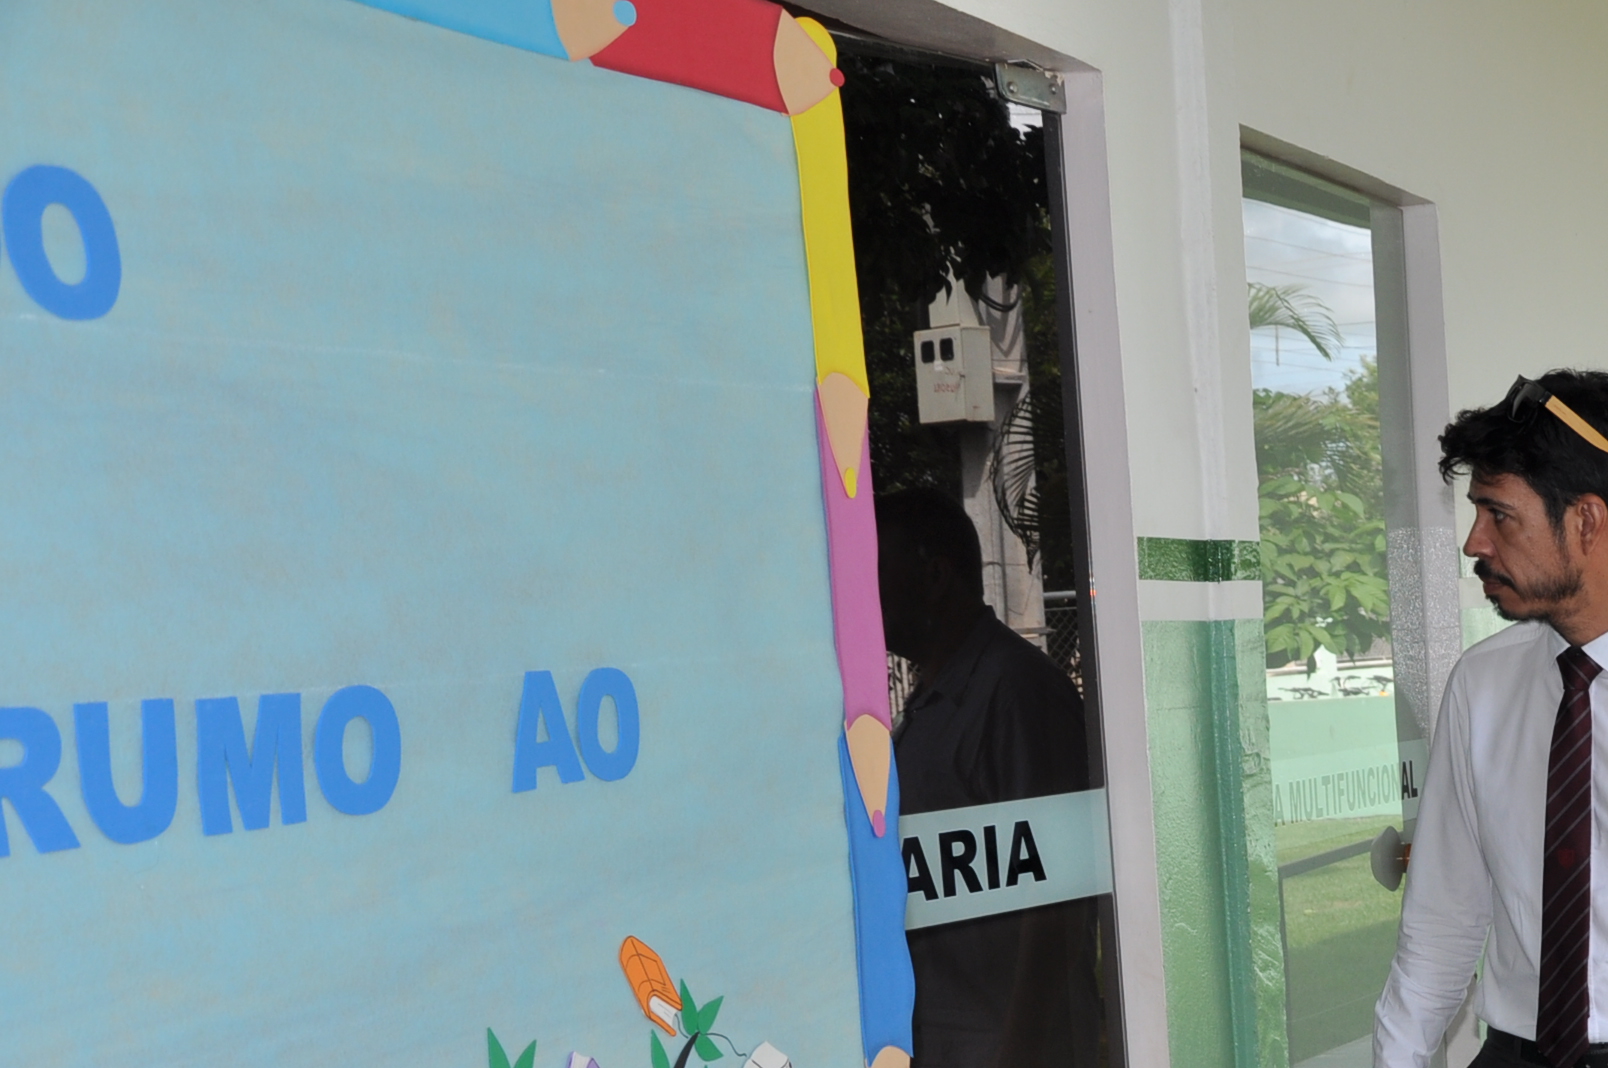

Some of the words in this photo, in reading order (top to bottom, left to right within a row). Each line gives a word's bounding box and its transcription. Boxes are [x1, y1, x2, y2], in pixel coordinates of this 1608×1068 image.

[0, 684, 401, 859] RUMO
[511, 666, 641, 794] AO
[1288, 759, 1419, 825] MULTIFUNCIONAL
[901, 820, 1047, 901] ARIA
